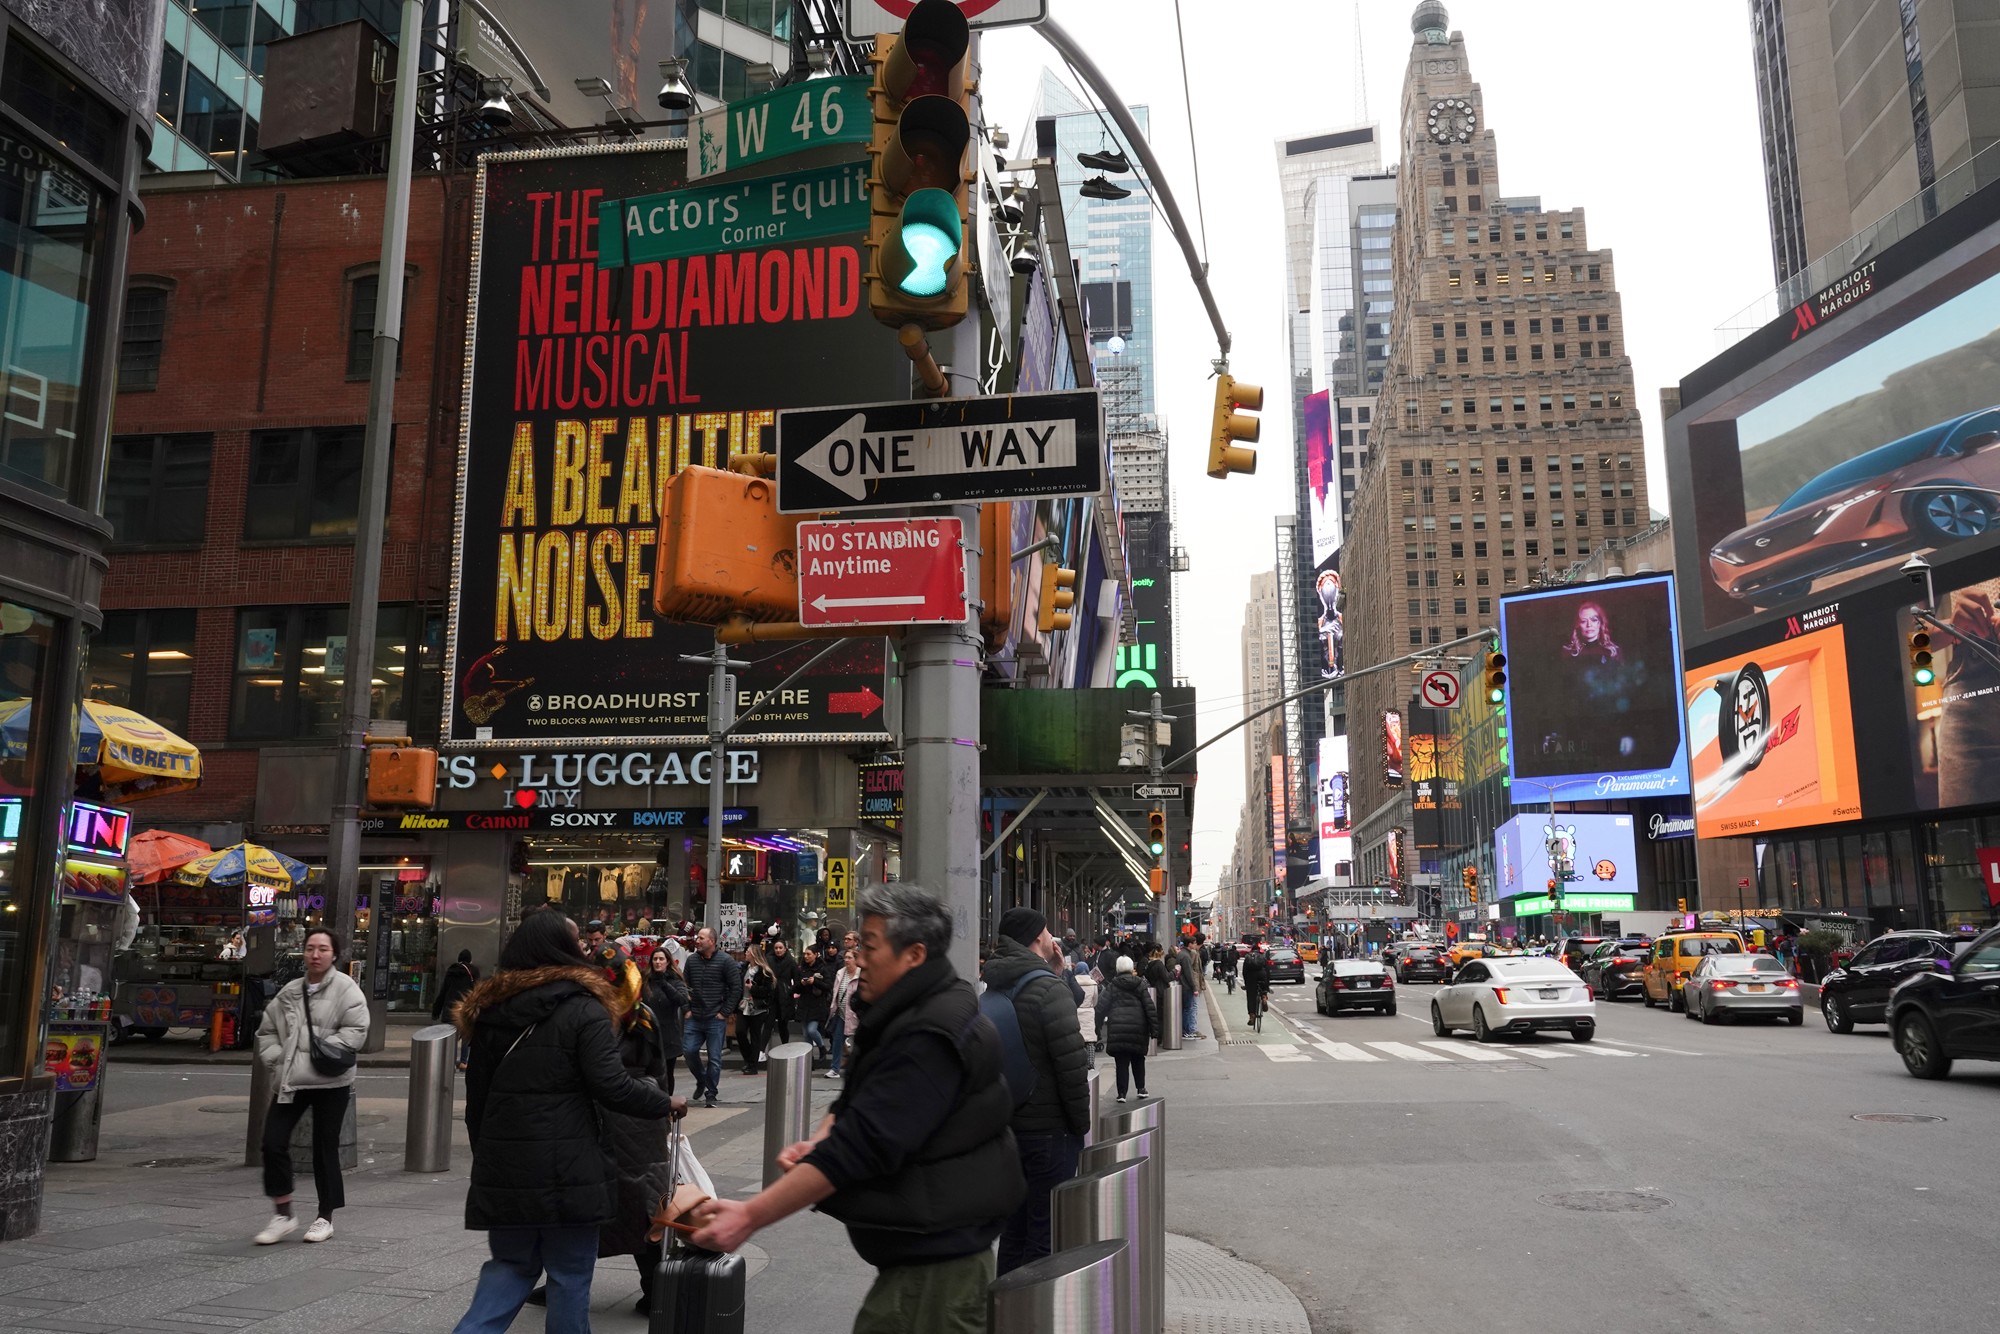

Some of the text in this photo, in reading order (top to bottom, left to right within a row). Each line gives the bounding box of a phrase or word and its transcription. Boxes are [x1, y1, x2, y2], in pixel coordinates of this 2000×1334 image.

[736, 86, 844, 157] W 46
[627, 167, 868, 237] Actors' Equit
[527, 188, 603, 262] THE
[721, 221, 786, 245] Corner
[518, 244, 860, 336] NEIL DIAMOND
[1819, 260, 1876, 304] MARRIOTT
[1821, 280, 1871, 318] MARQUIS
[514, 331, 701, 411] MUSICAL
[828, 425, 1057, 477] ONE WAY
[501, 420, 537, 527] A
[965, 488, 986, 496] DEPT
[1013, 483, 1087, 493] TRANSPORTATION
[807, 529, 940, 552] NO STANDING
[809, 556, 892, 579] Anytime
[494, 527, 656, 642] NOISE
[1132, 578, 1155, 587] potify
[1803, 602, 1840, 621] MARRIOTT
[1803, 614, 1837, 631] MARQUIS
[548, 691, 701, 711] BROADHURST
[1962, 690, 1977, 699] JEAN
[1977, 687, 1993, 696] MADE
[527, 718, 549, 726] TWO
[550, 717, 587, 726] BLOCKS
[589, 716, 618, 725] AWAY!
[620, 716, 647, 724] WEST
[648, 715, 672, 724] 44TH
[673, 715, 709, 724] BETWE
[764, 713, 782, 721] 8TH
[784, 712, 809, 721] AVES
[109, 741, 195, 771] SABRETT
[518, 750, 759, 788] LUGGAGE
[1419, 782, 1429, 790] THE
[1595, 774, 1679, 796] Paramount+
[538, 789, 580, 808] NY
[866, 797, 893, 811] CAMERA
[360, 817, 384, 832] pple
[400, 814, 449, 829] Nikon
[466, 814, 530, 829] Canon
[550, 812, 617, 827] SONY
[633, 811, 684, 826] BOWER
[1833, 806, 1861, 816] #Swatch
[1648, 813, 1695, 840] Paramoun
[1721, 819, 1755, 831] SWISS MADE
[250, 874, 290, 889] SABRETT
[830, 861, 844, 900] ATM
[1479, 909, 1489, 917] 25
[1564, 898, 1587, 909] LINE
[1588, 897, 1632, 908] FRIENDS
